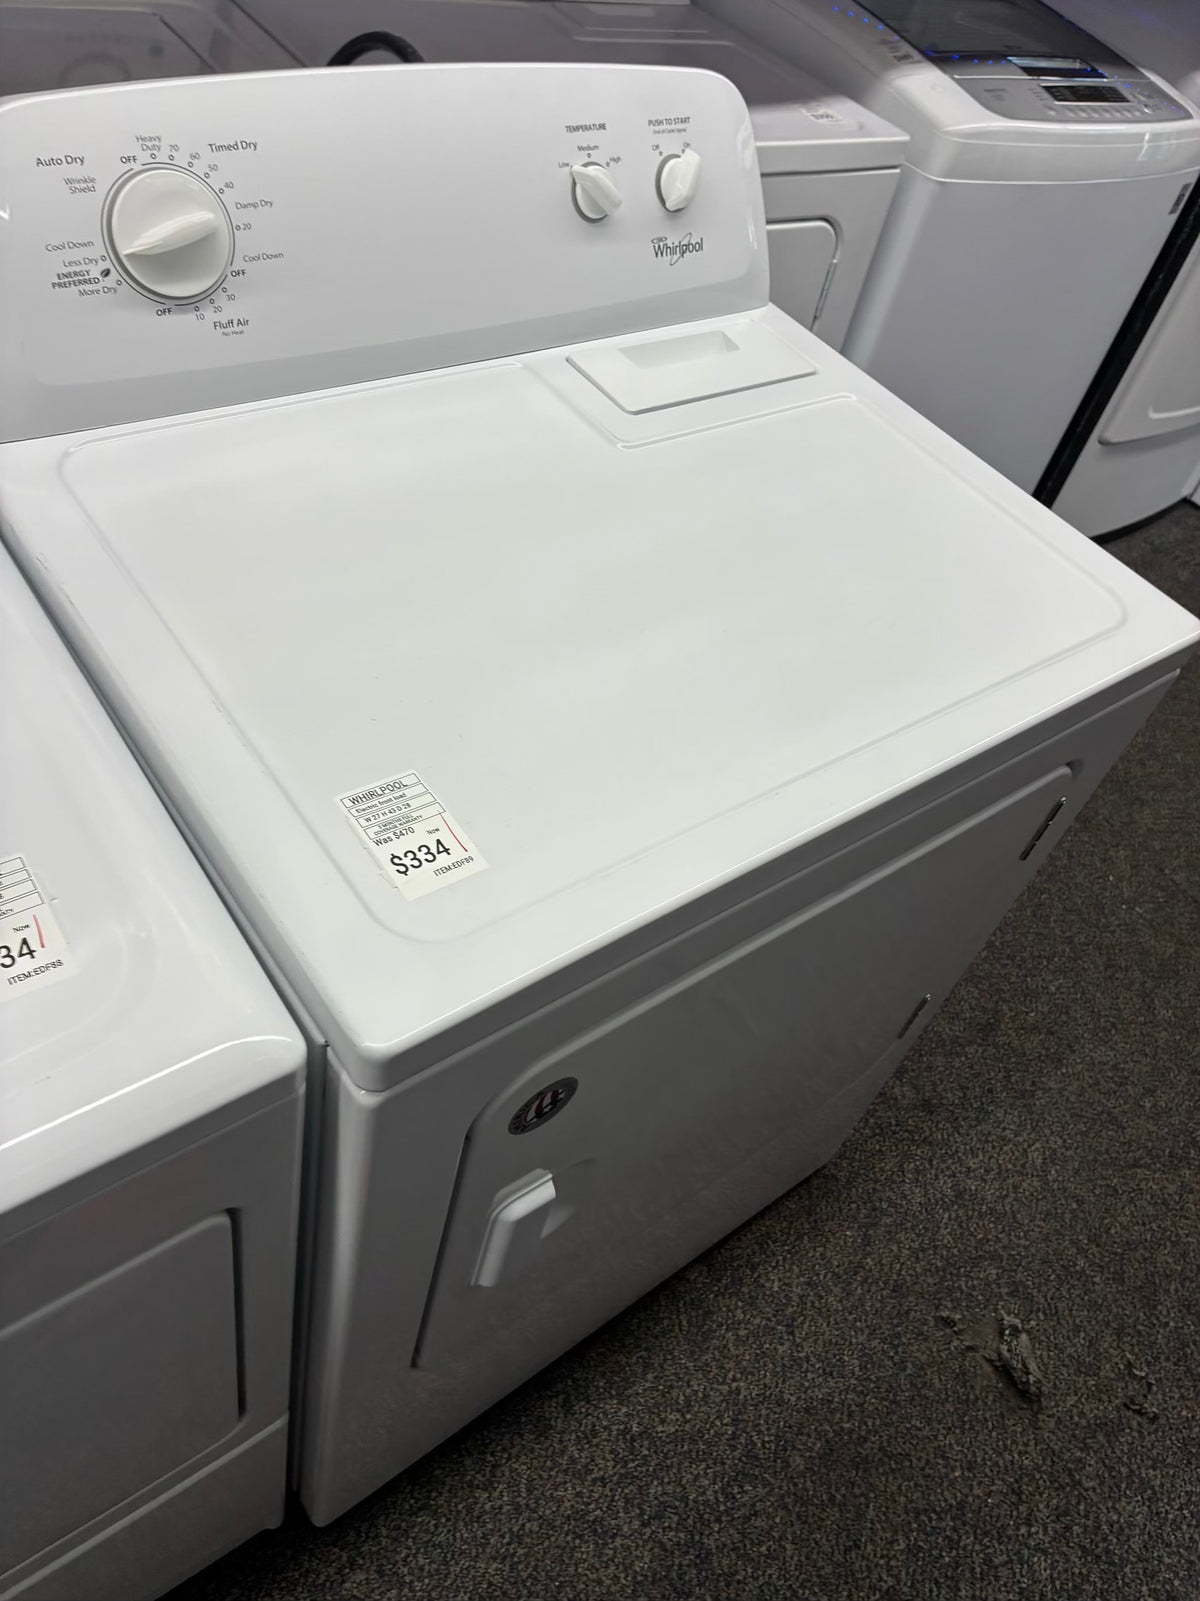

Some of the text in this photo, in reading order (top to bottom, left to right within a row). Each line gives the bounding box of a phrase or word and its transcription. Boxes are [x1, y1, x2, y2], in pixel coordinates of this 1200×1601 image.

[648, 116, 691, 127] PUSH TO START
[565, 123, 607, 133] TEMPERATURE
[136, 135, 162, 144] Heavy
[141, 143, 161, 153] Duty
[169, 144, 180, 152] 70
[208, 140, 258, 153] Timed Dry
[36, 154, 85, 167] Auto Dry
[120, 155, 137, 164] OFF
[190, 152, 201, 160] 60
[609, 156, 622, 164] High
[208, 163, 218, 172] 50
[63, 176, 97, 185] Wrinkle
[223, 181, 234, 189] 40
[69, 185, 97, 194] Shield
[235, 199, 273, 210] Damp Dry
[242, 222, 252, 230] 20
[45, 240, 95, 252] Cool Down
[652, 236, 703, 260] Whirlpool
[63, 256, 98, 267] Less Dry
[243, 251, 284, 263] Cool Down
[57, 269, 91, 280] ENERGY
[231, 269, 246, 277] OFF
[52, 277, 100, 289] PREFERRED
[79, 285, 117, 297] More Dry
[226, 293, 236, 301] 30
[156, 307, 172, 316] OFF
[213, 305, 222, 313] 20
[195, 312, 205, 320] 10
[214, 317, 249, 330] Fluff Air
[348, 780, 408, 805] WHIRLPOOL
[355, 793, 407, 814] Electric front load
[373, 827, 415, 847] Was $470
[427, 828, 440, 836] Now
[390, 838, 451, 876] $334
[12, 924, 30, 933] Now
